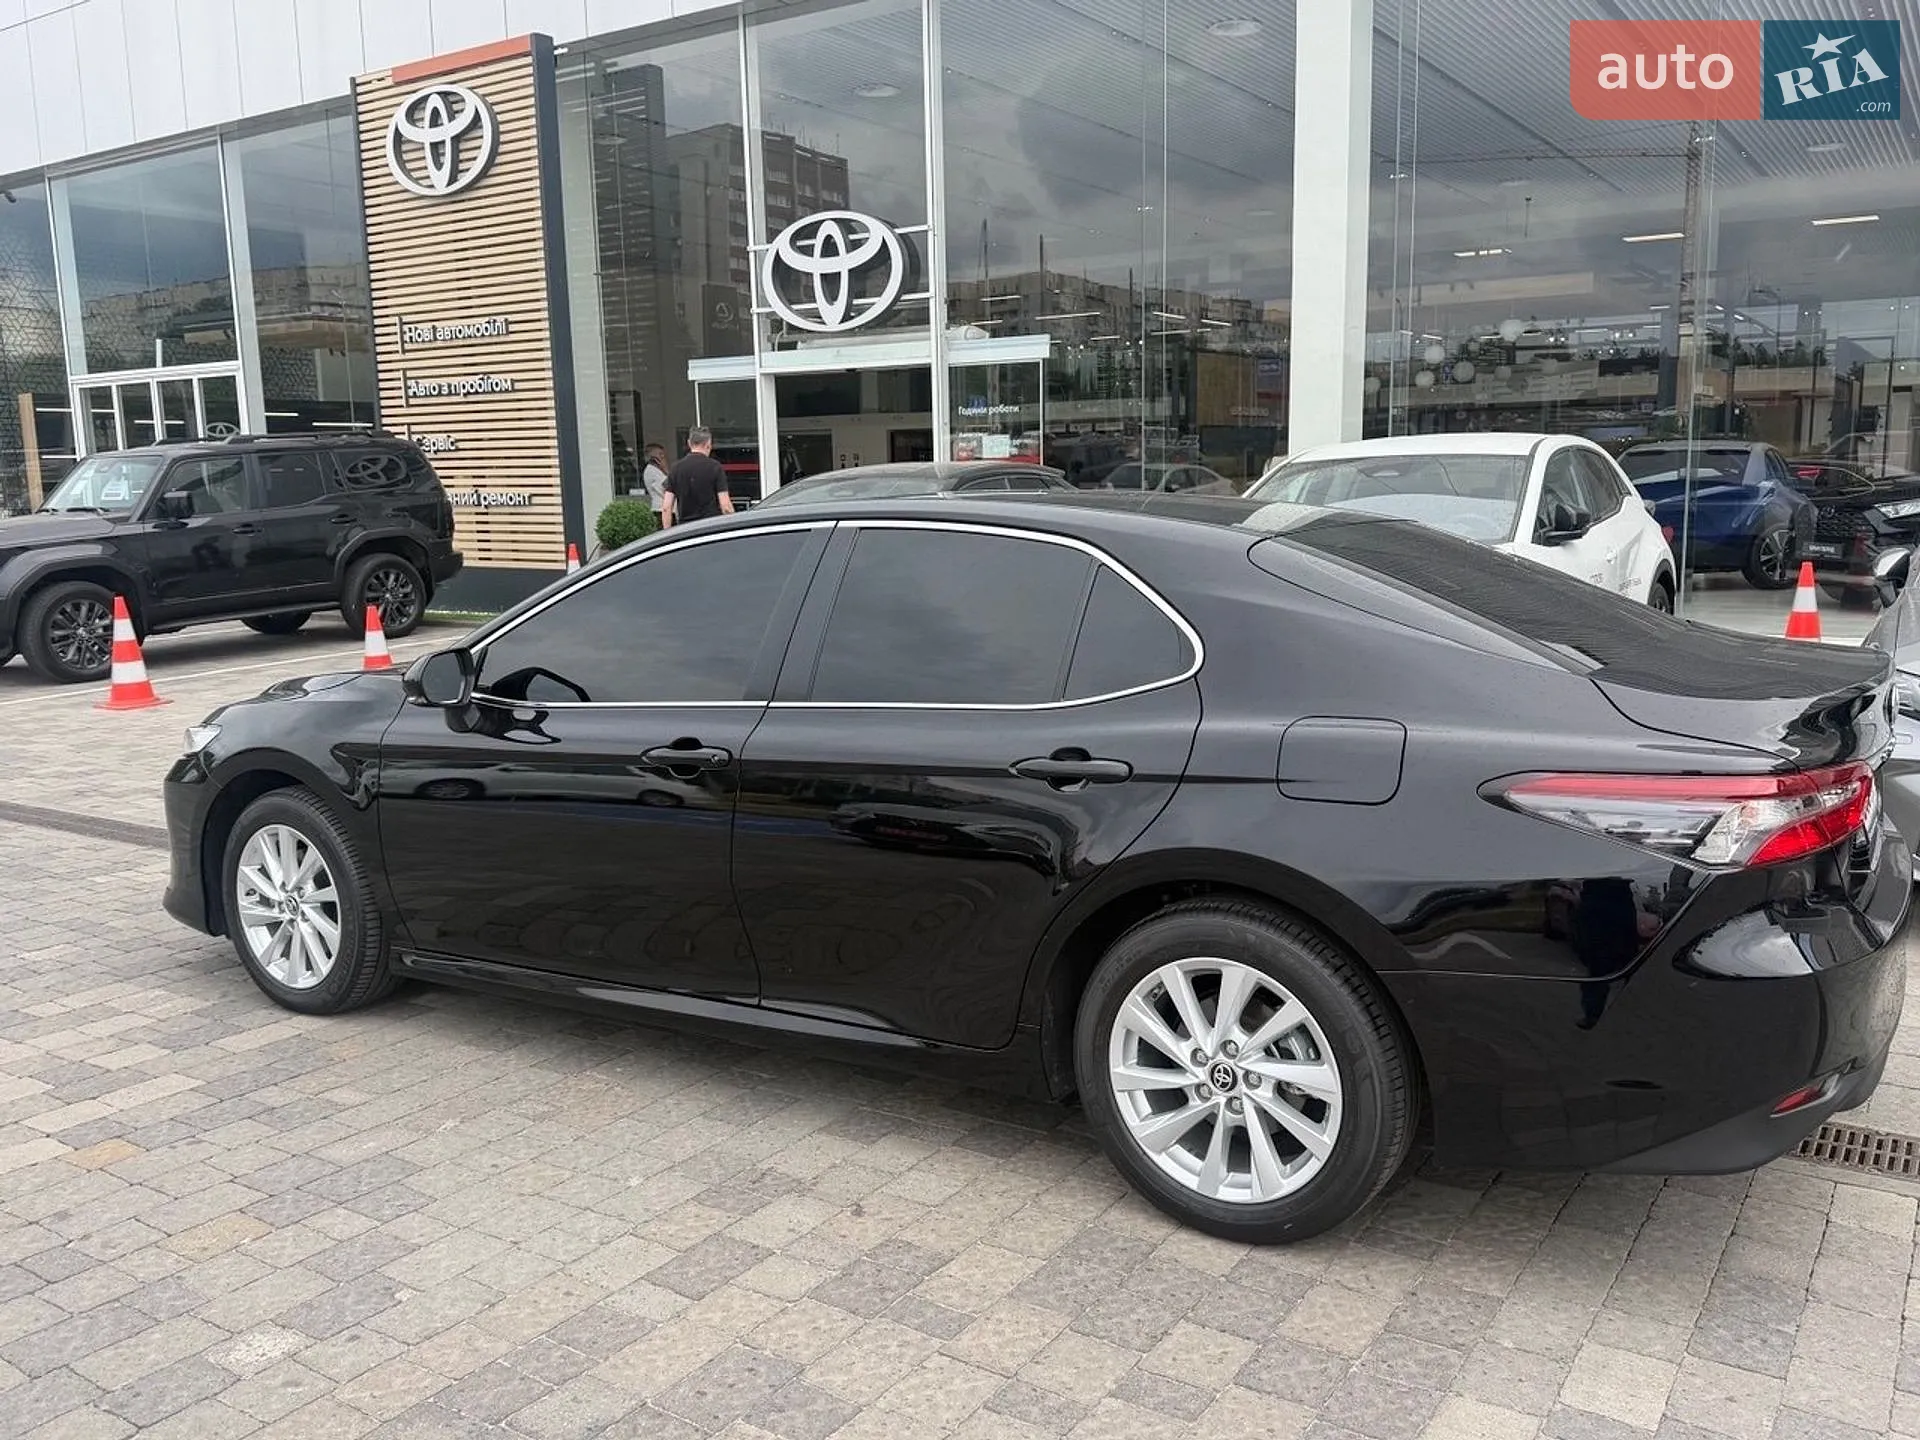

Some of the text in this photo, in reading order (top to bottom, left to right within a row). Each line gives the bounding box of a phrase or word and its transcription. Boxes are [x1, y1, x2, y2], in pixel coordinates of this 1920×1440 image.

[405, 318, 507, 343] Нові автомобілі
[408, 374, 512, 397] Авто з пробігом
[988, 404, 1020, 416] роботи
[480, 492, 530, 508] ремонт
